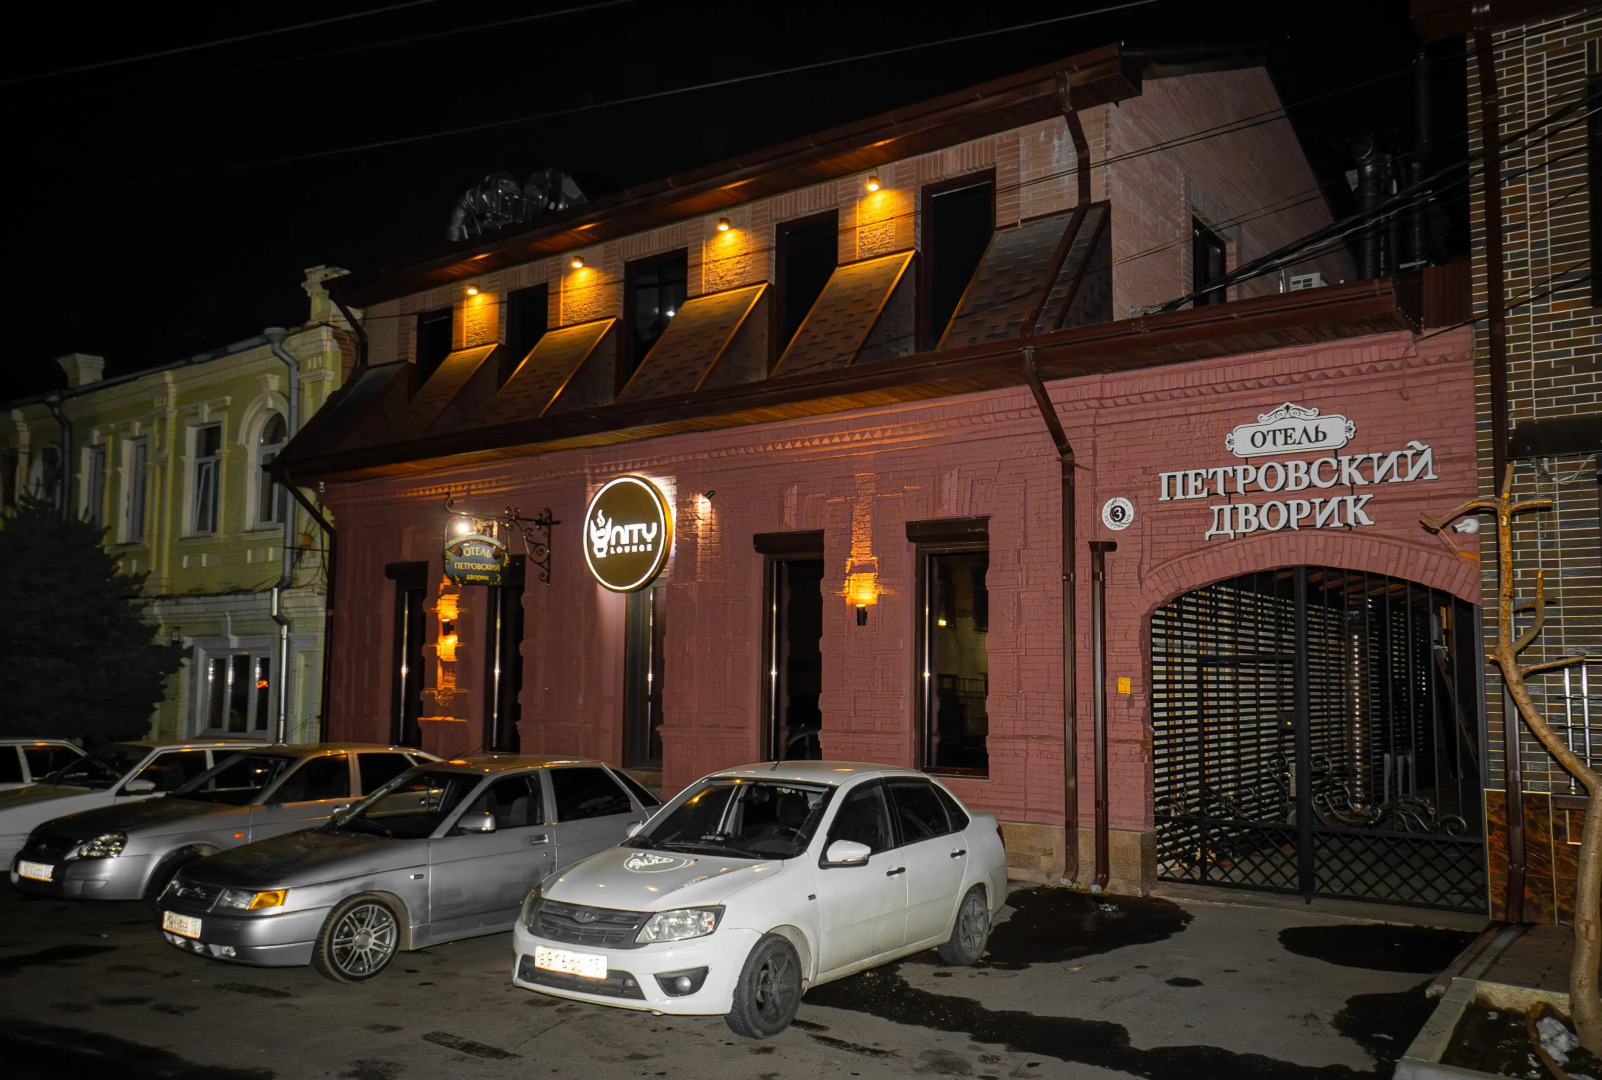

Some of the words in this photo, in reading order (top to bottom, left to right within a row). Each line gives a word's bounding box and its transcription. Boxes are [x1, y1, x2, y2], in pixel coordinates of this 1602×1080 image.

[1250, 425, 1328, 449] ОТЕЛЬ
[1159, 440, 1439, 501] ПЕТРОВСКИЙ
[1113, 507, 1123, 521] 3
[1205, 493, 1375, 541] ДВОРИК
[463, 546, 492, 558] ОТЕЛЬ
[610, 543, 653, 555] LOUNGE
[454, 561, 501, 572] ПЕТРОВСКИЙ
